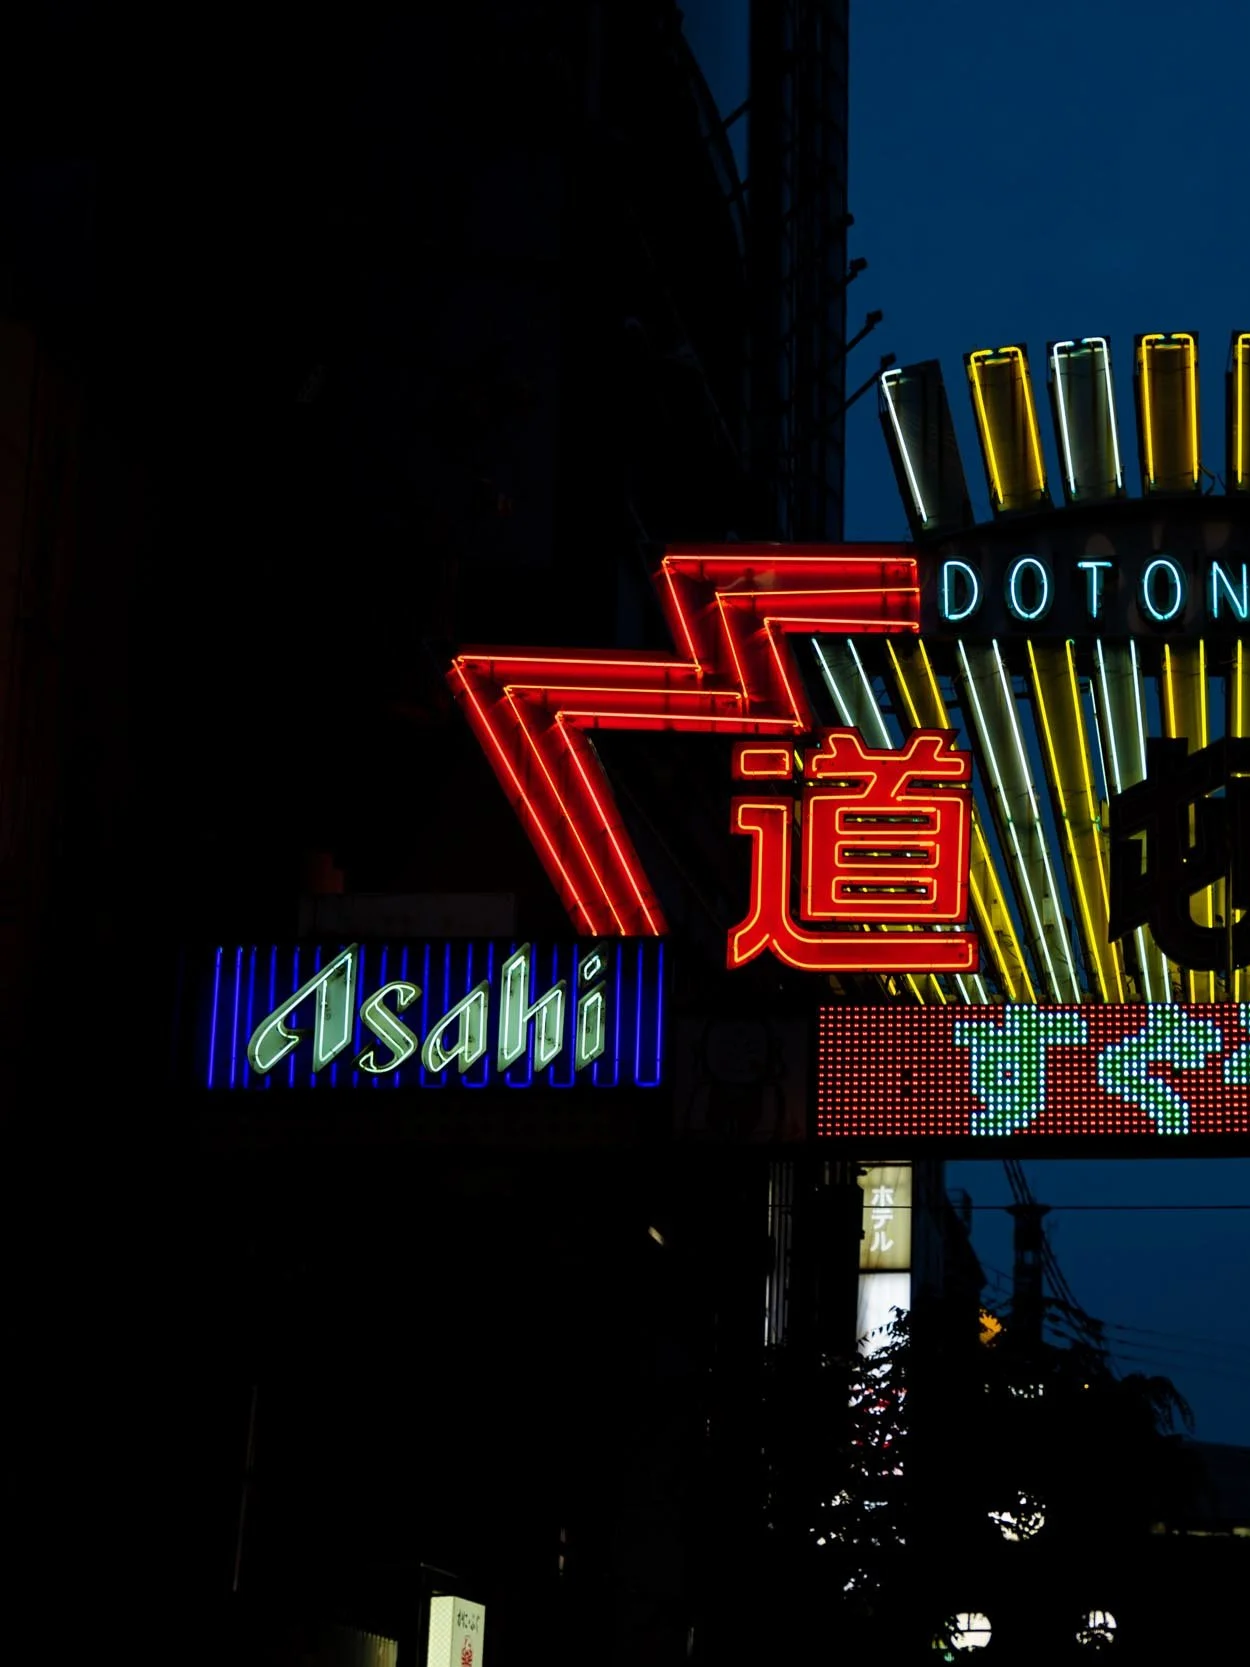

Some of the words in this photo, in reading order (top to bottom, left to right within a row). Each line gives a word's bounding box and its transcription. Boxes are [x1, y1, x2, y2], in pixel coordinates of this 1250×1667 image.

[247, 943, 608, 1075] Asahi
[869, 1185, 894, 1253] ホテル
